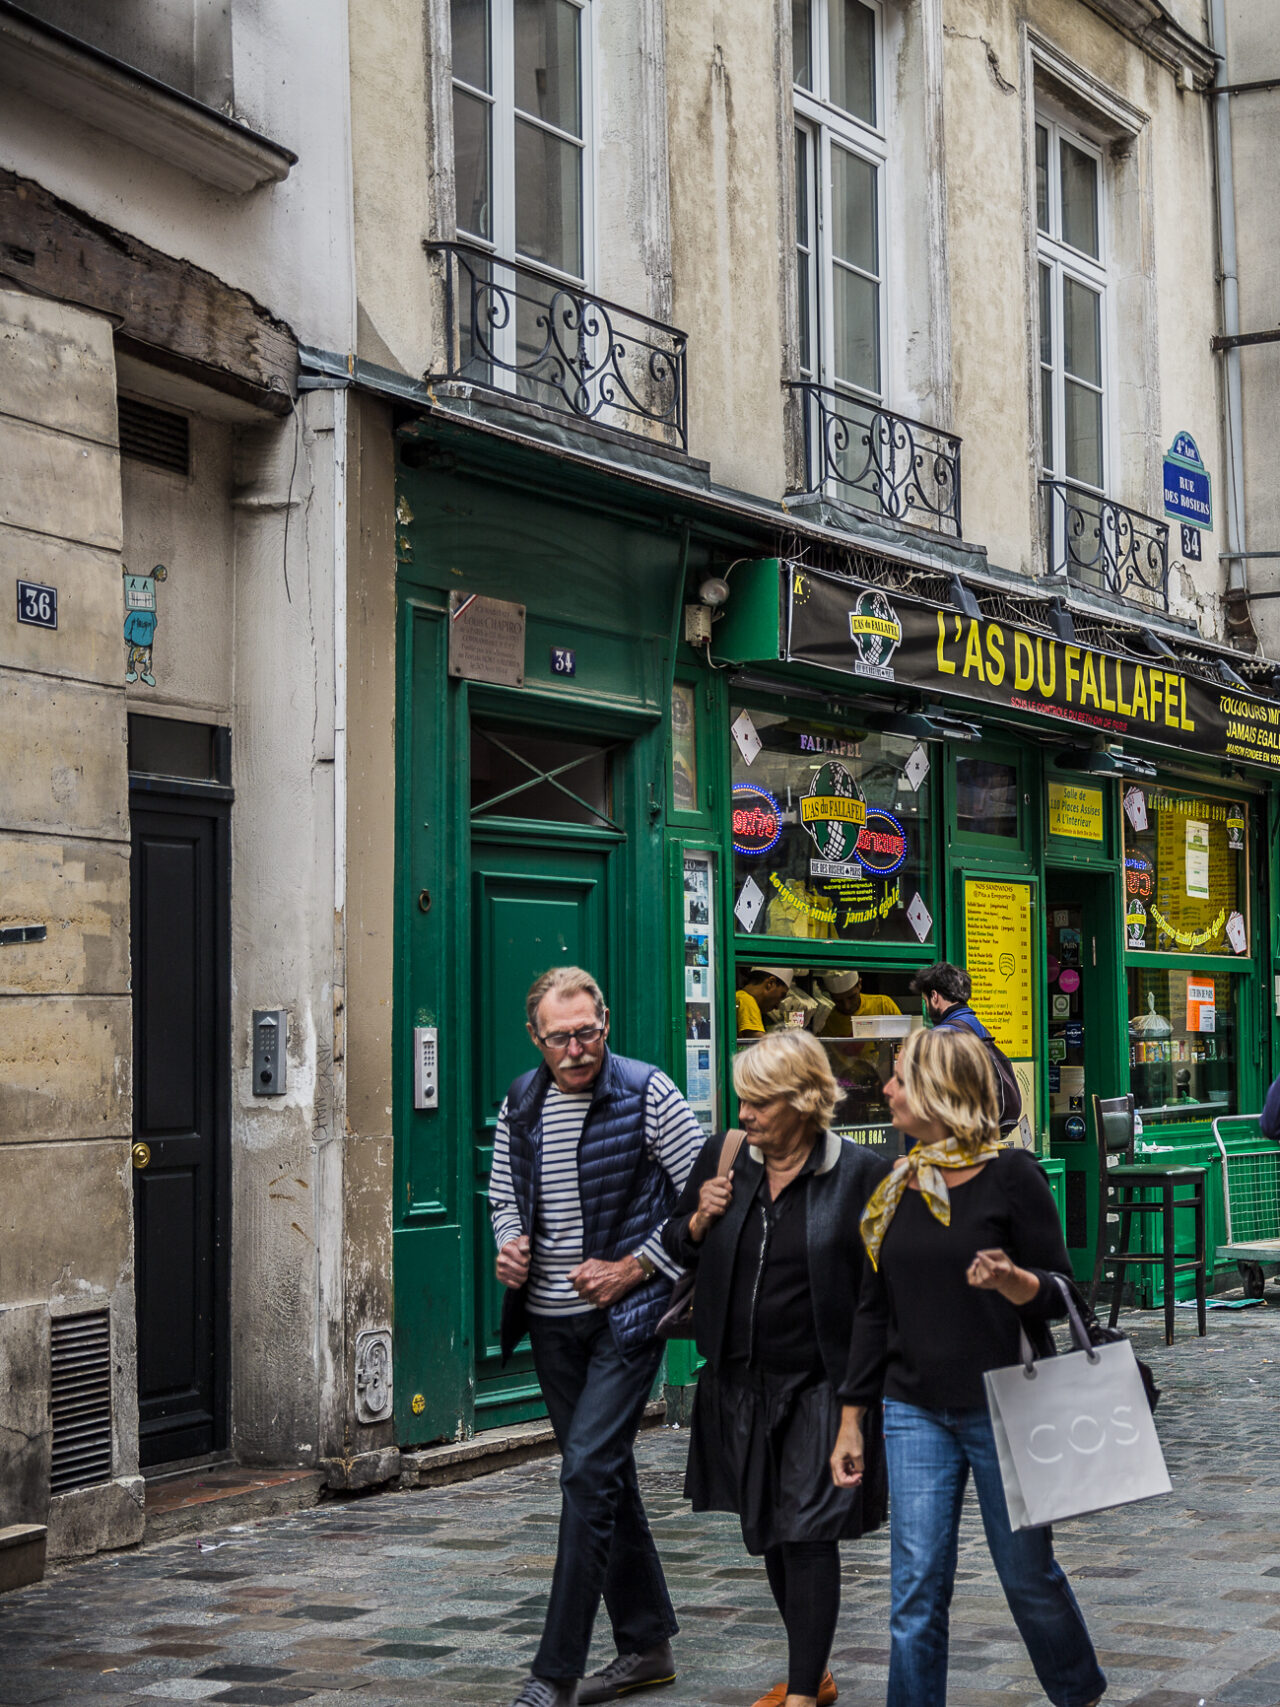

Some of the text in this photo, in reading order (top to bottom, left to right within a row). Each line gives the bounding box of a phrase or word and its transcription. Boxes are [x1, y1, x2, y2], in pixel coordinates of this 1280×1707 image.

[1180, 477, 1194, 493] RUE
[1165, 489, 1209, 516] DES ROSIERS
[1183, 529, 1199, 556] 34
[794, 575, 804, 595] K
[25, 588, 51, 620] 36
[872, 621, 898, 637] FALLAFEL
[556, 650, 572, 673] 34
[937, 611, 1195, 732] L'AS DU FALLAFEL
[1011, 697, 1027, 711] SOUS
[1028, 701, 1036, 712] LE
[1037, 703, 1068, 719] CONTROLE
[1069, 710, 1077, 720] DU
[1103, 718, 1112, 728] DE
[1112, 720, 1128, 732] PARIS
[1220, 696, 1267, 722] TOUJOURS
[1226, 721, 1257, 743] JAMAIS
[800, 734, 862, 758] FALLAFEL
[1226, 743, 1280, 765] MAISON FONDEE EN 1979
[1064, 788, 1086, 801] Salle de
[804, 799, 864, 821] L'AS du FALLAFEL
[1057, 813, 1060, 823] A
[1062, 800, 1079, 813] Places
[1080, 804, 1100, 816] Assises
[769, 872, 837, 923] toujours imité
[843, 903, 877, 928] jamais
[1026, 1405, 1140, 1464] COS
